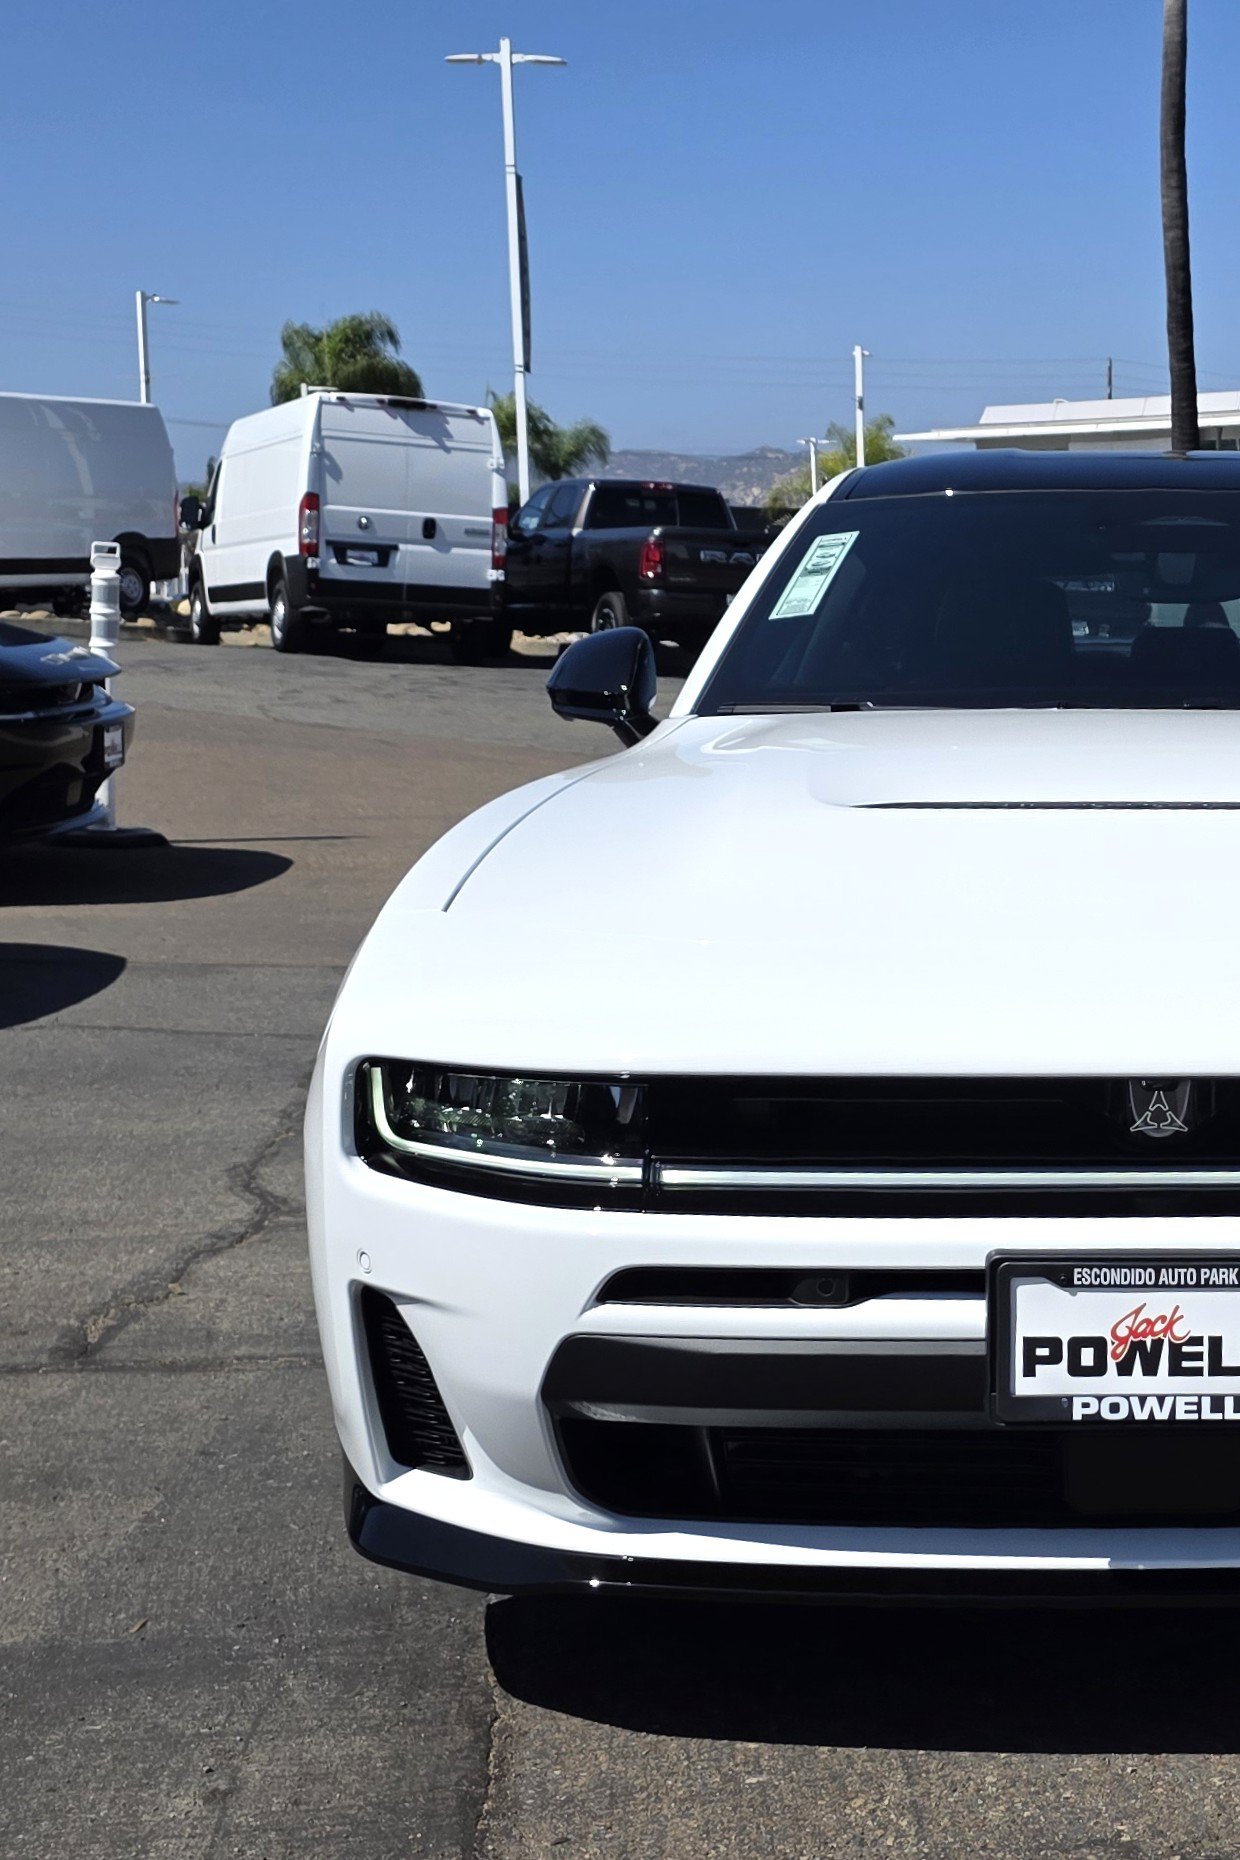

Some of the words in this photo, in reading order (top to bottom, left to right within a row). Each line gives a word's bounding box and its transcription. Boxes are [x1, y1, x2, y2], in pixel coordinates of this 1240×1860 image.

[1073, 1268, 1155, 1285] ESCONDIDO
[1159, 1268, 1197, 1285] AUTO
[1200, 1268, 1239, 1285] PARK
[1110, 1303, 1191, 1362] Jack
